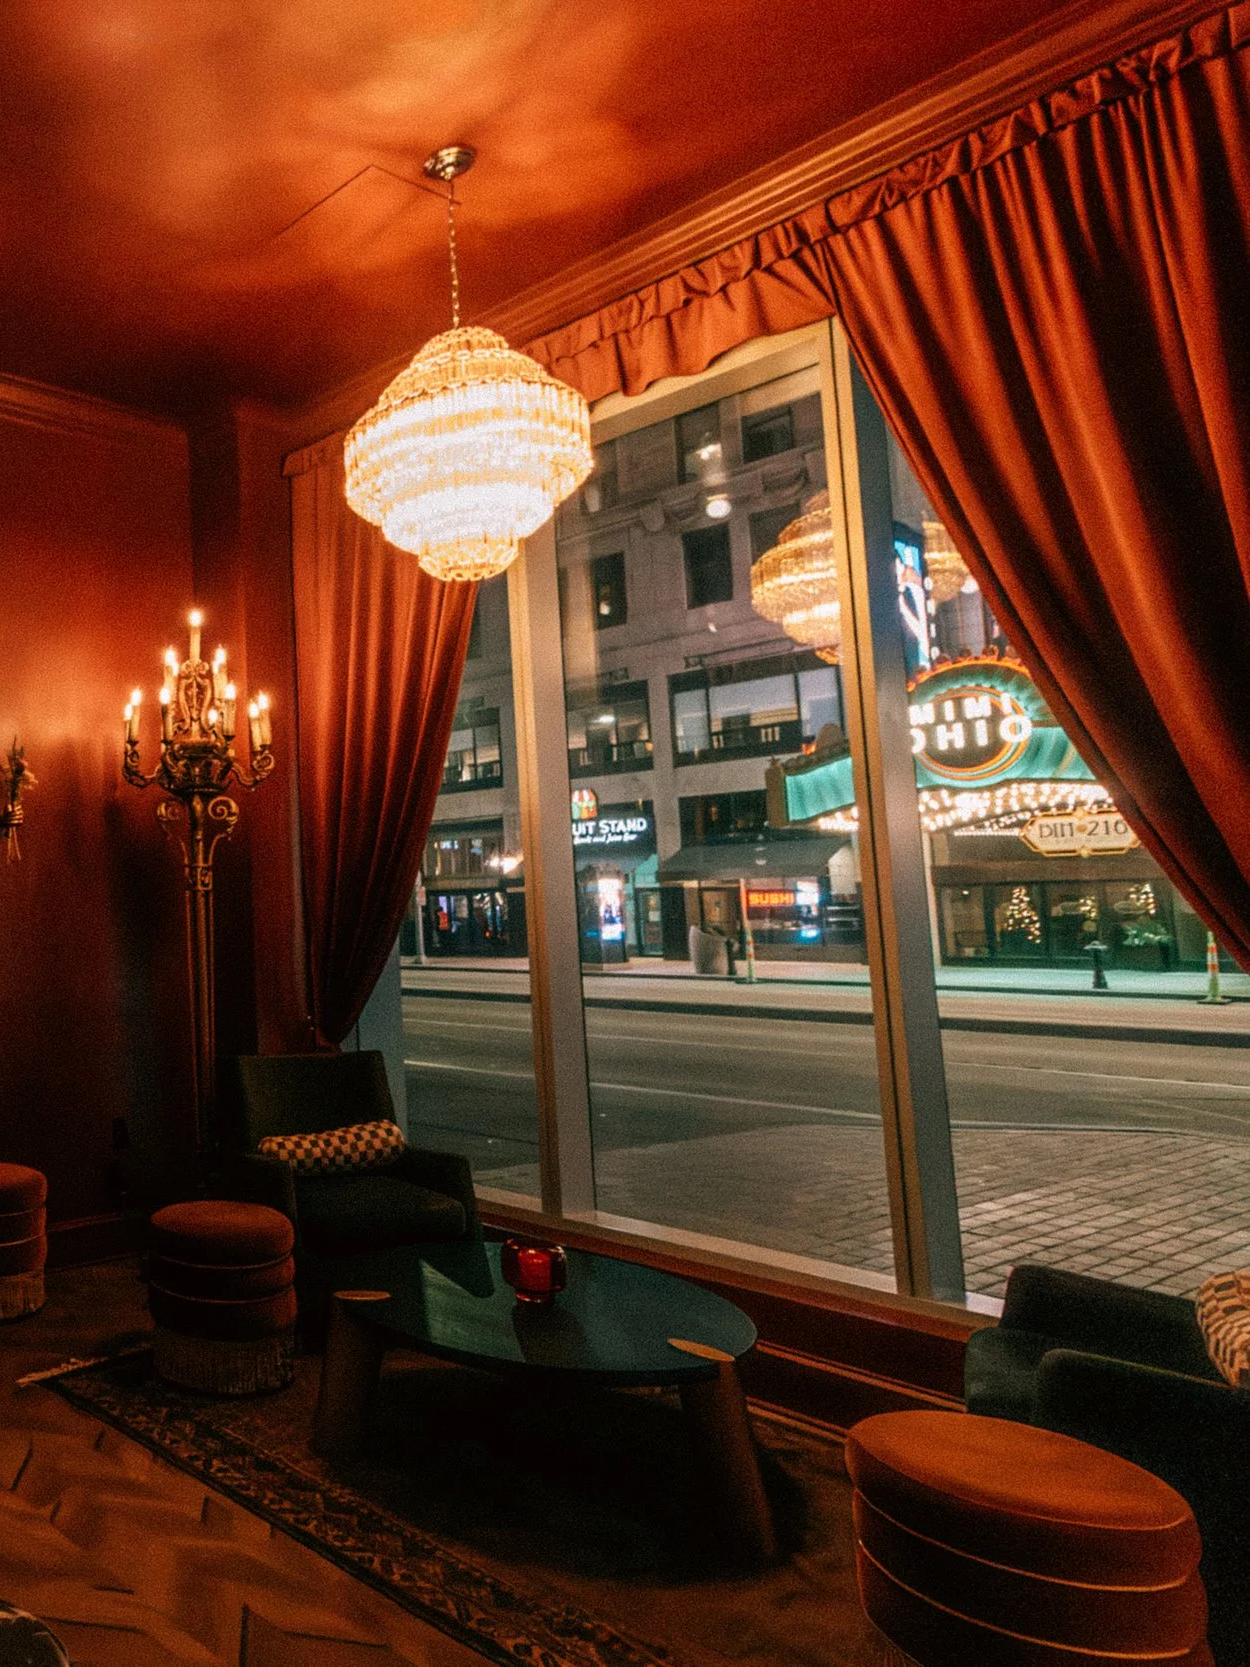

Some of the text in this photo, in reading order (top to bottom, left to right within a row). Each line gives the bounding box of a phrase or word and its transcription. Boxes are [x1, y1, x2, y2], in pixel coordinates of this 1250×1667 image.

[909, 692, 1012, 726] MIMI
[598, 817, 648, 835] STAND
[749, 892, 795, 906] SUSHI
